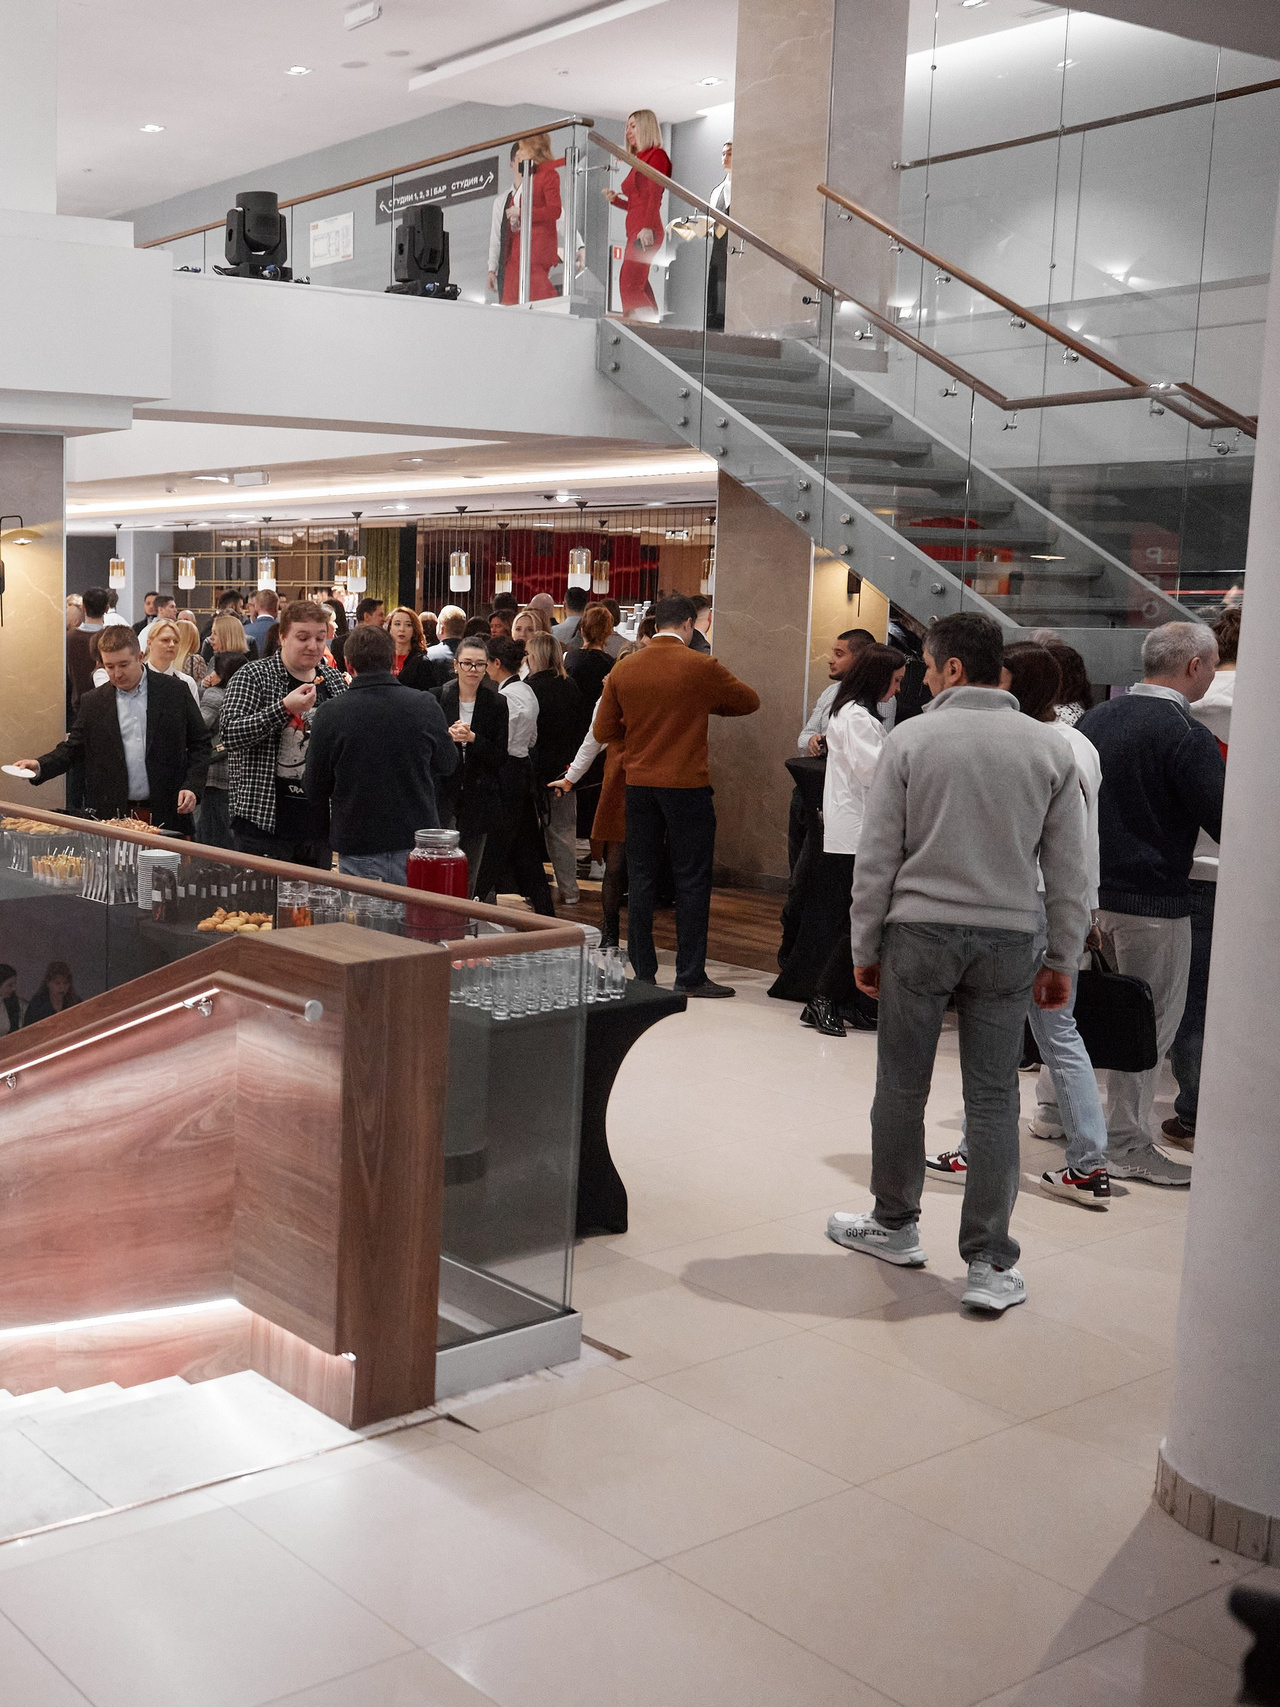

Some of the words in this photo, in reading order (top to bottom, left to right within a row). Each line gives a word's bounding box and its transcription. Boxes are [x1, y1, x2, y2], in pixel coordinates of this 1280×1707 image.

[451, 177, 478, 190] СТУДИЯ
[479, 175, 483, 183] 4
[388, 193, 413, 207] СТУДИИ
[414, 192, 419, 201] 1,
[419, 191, 425, 200] 2,
[425, 189, 430, 197] 3
[433, 185, 447, 195] БАР
